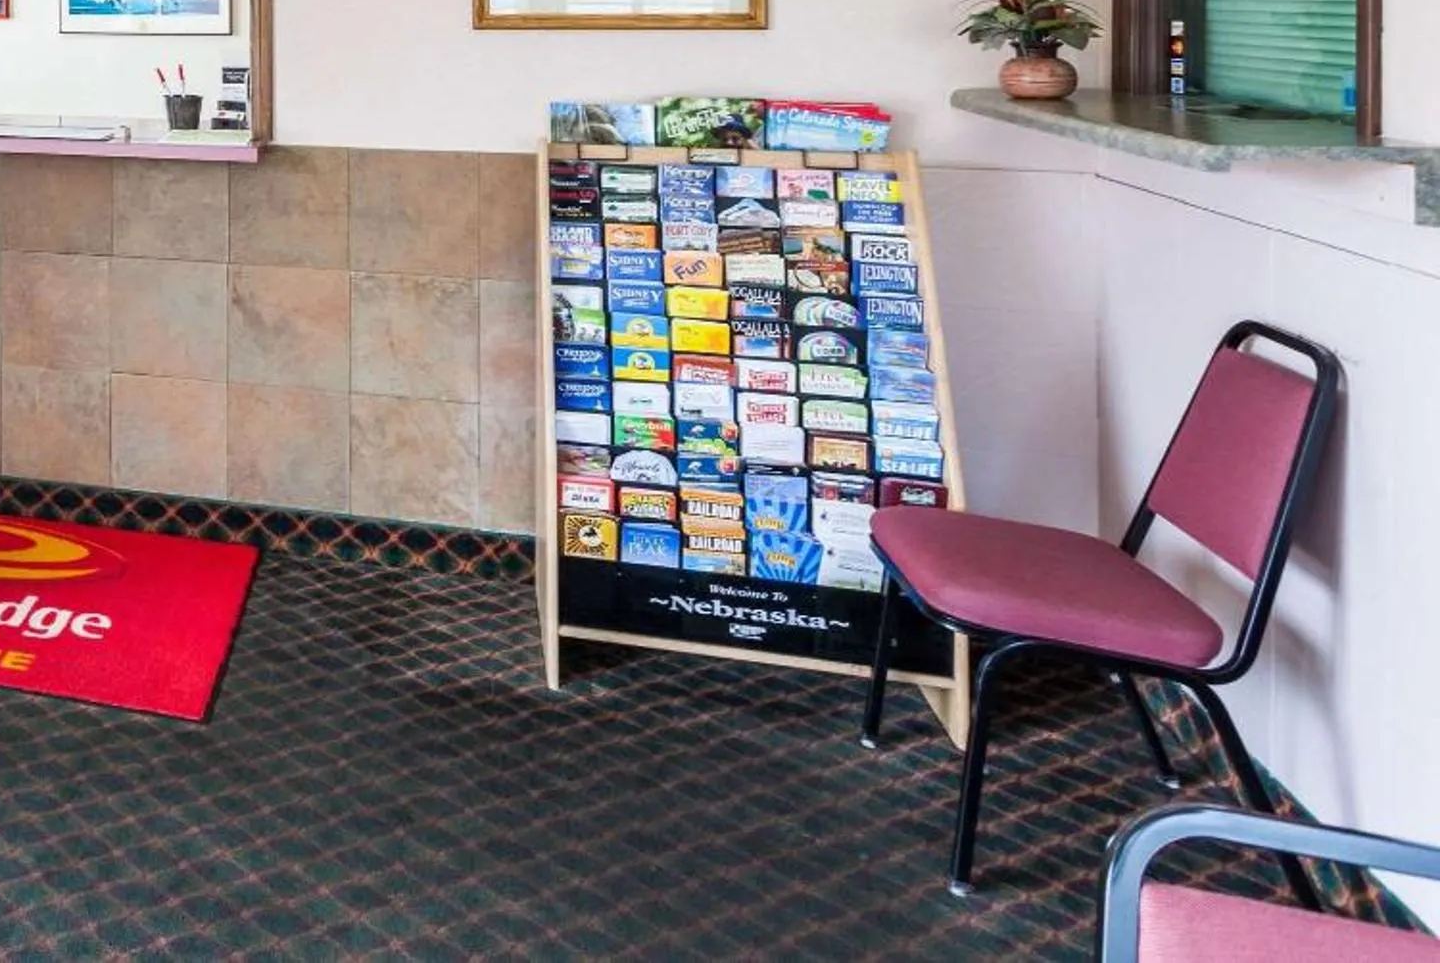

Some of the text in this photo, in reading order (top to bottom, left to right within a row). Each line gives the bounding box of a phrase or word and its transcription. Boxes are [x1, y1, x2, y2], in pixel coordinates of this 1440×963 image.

[610, 255, 658, 269] SIDNEY
[674, 258, 708, 280] Fun
[862, 265, 916, 288] LEXINGTON
[612, 288, 663, 302] SIDNEY
[867, 299, 924, 324] LEXINGTON
[688, 501, 740, 520] RAILROAD
[689, 536, 742, 553] RAILROAD
[709, 584, 789, 603] Welcome To
